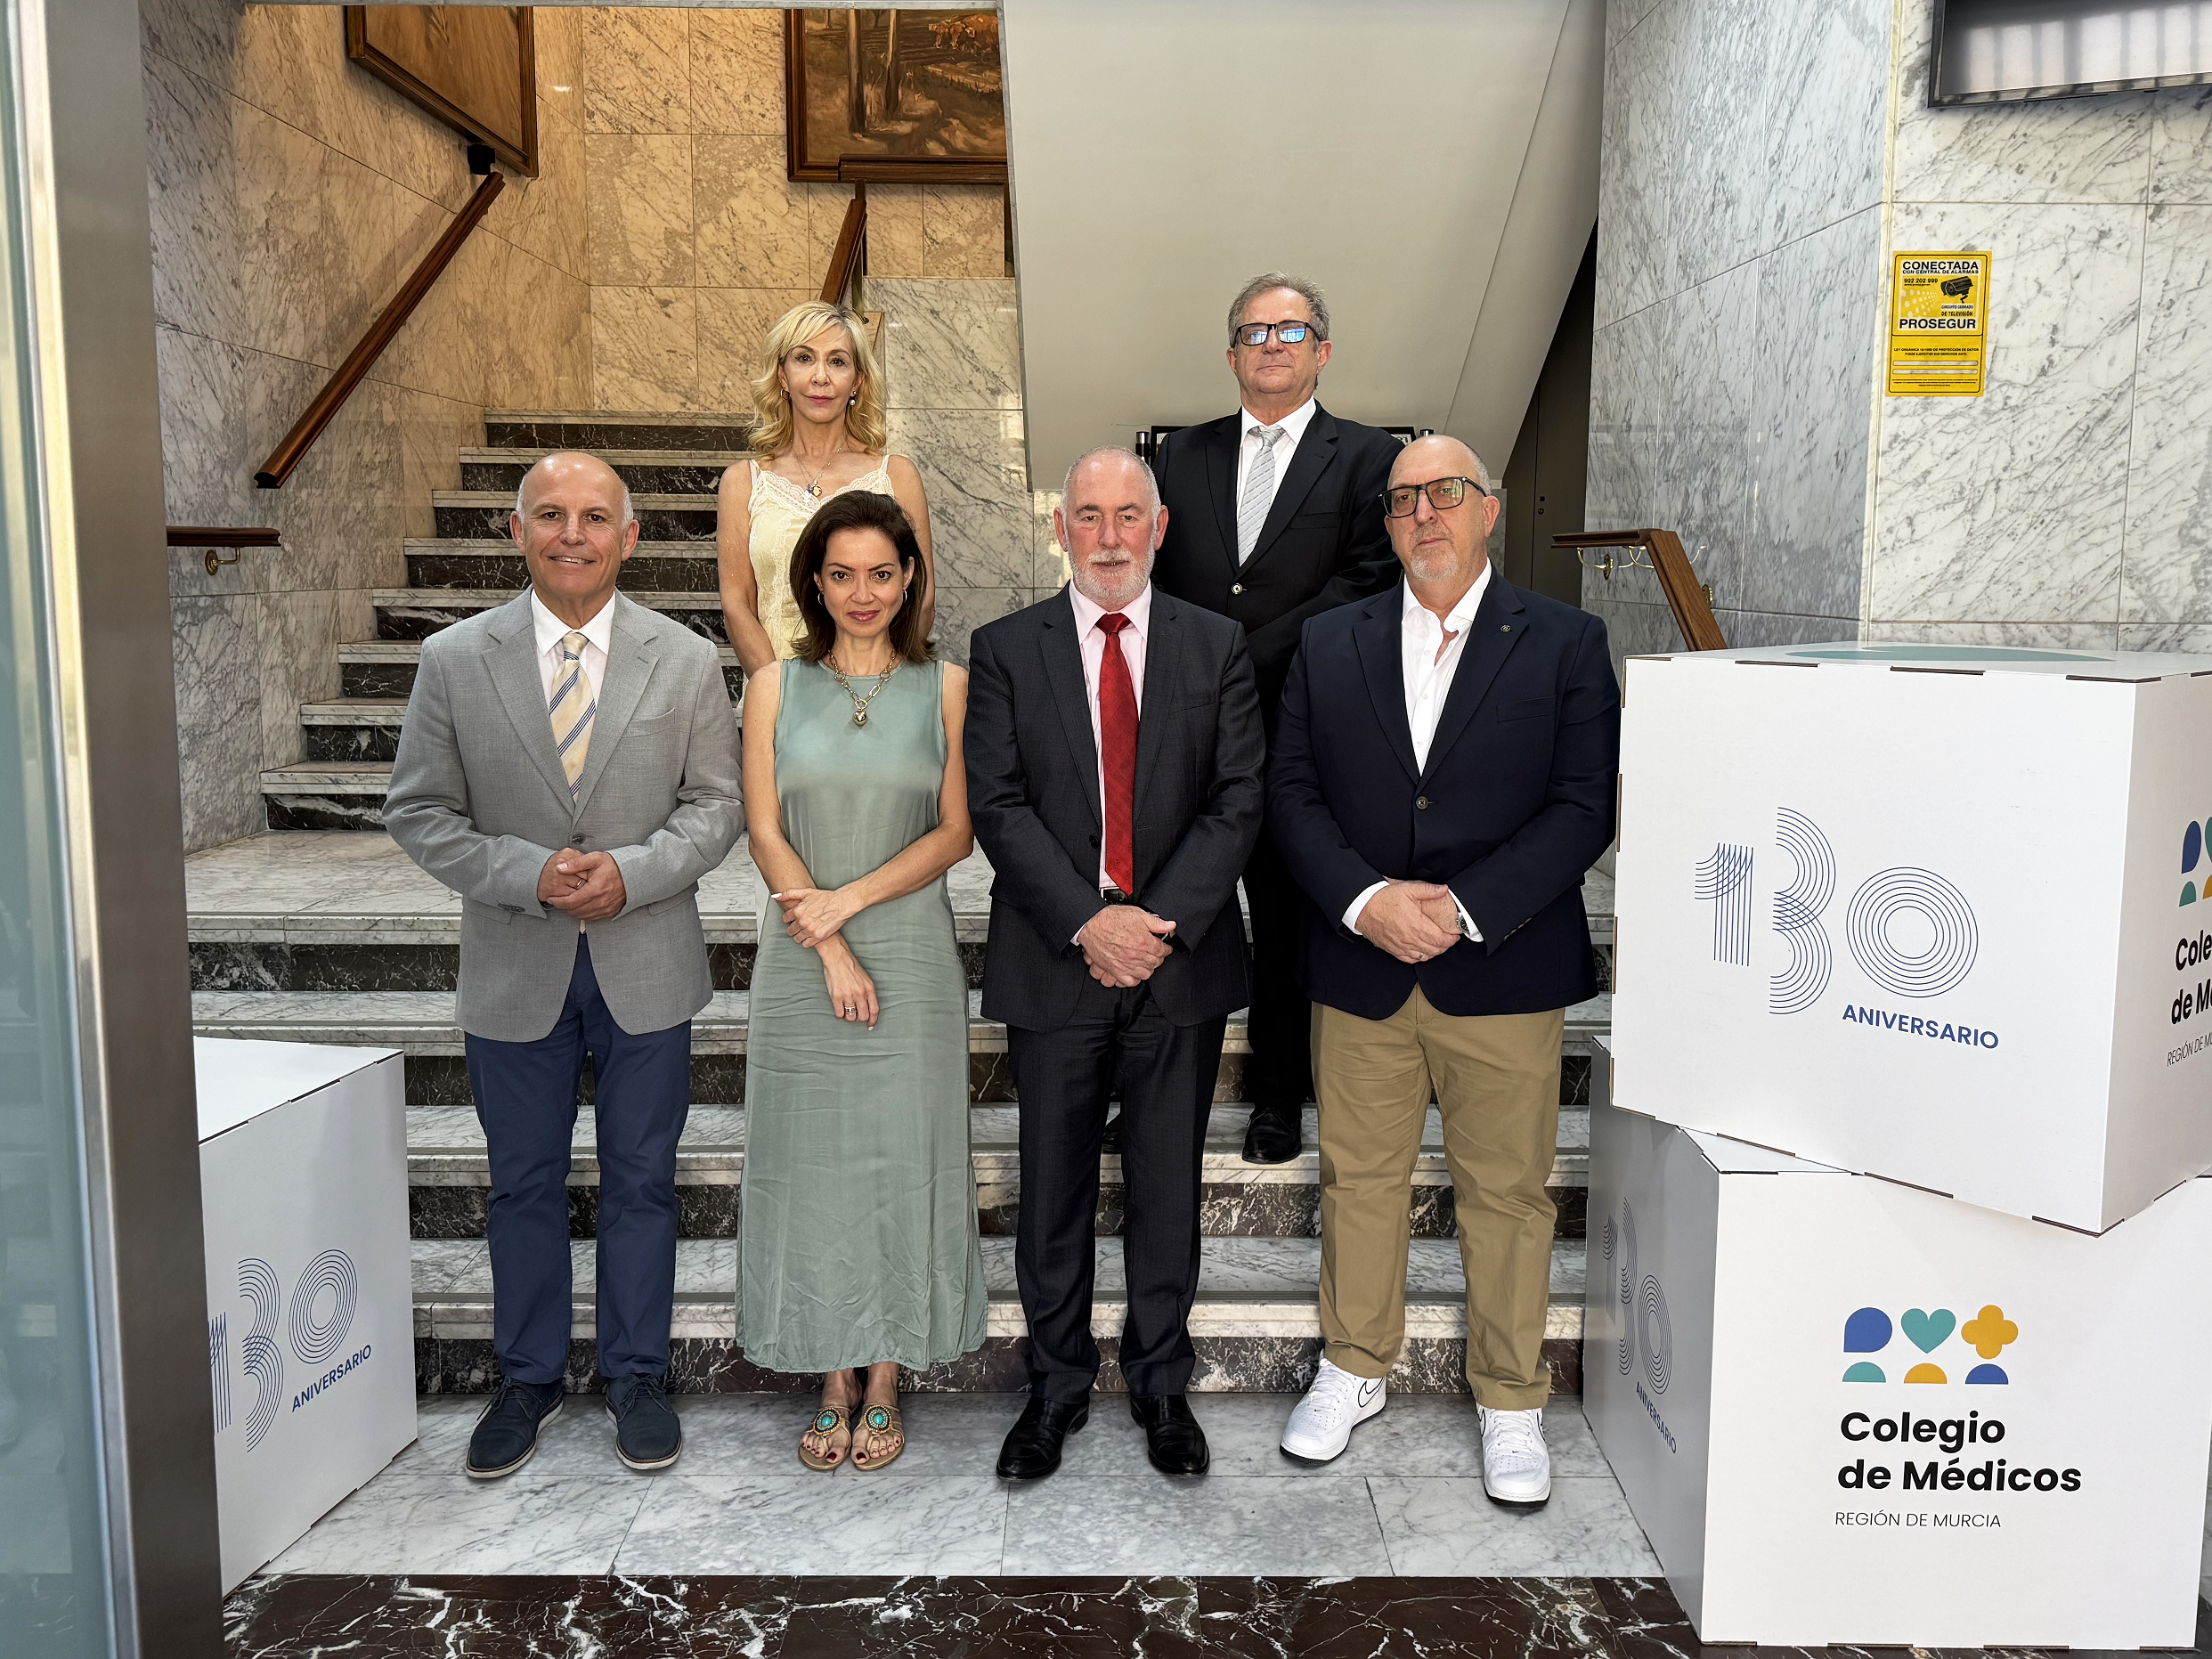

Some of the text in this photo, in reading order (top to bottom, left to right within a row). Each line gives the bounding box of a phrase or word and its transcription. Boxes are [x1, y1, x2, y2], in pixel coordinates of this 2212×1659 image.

[1902, 261, 1979, 270] CONECTADA
[1899, 319, 1976, 329] PROSEGUR
[1695, 807, 1979, 1014] 130
[2171, 988, 2192, 1024] de
[1842, 1004, 1999, 1049] ANIVERSARIO
[2167, 1040, 2193, 1067] REGIÓN
[2194, 1036, 2203, 1053] DE
[291, 1345, 372, 1412] ANIVERSARIO
[1636, 1381, 1678, 1454] ANIVERSARIO
[1840, 1410, 2005, 1453] Colegio
[1837, 1457, 2082, 1492] de Médicos
[1834, 1509, 2002, 1528] REGIÓN DE MURCIA
